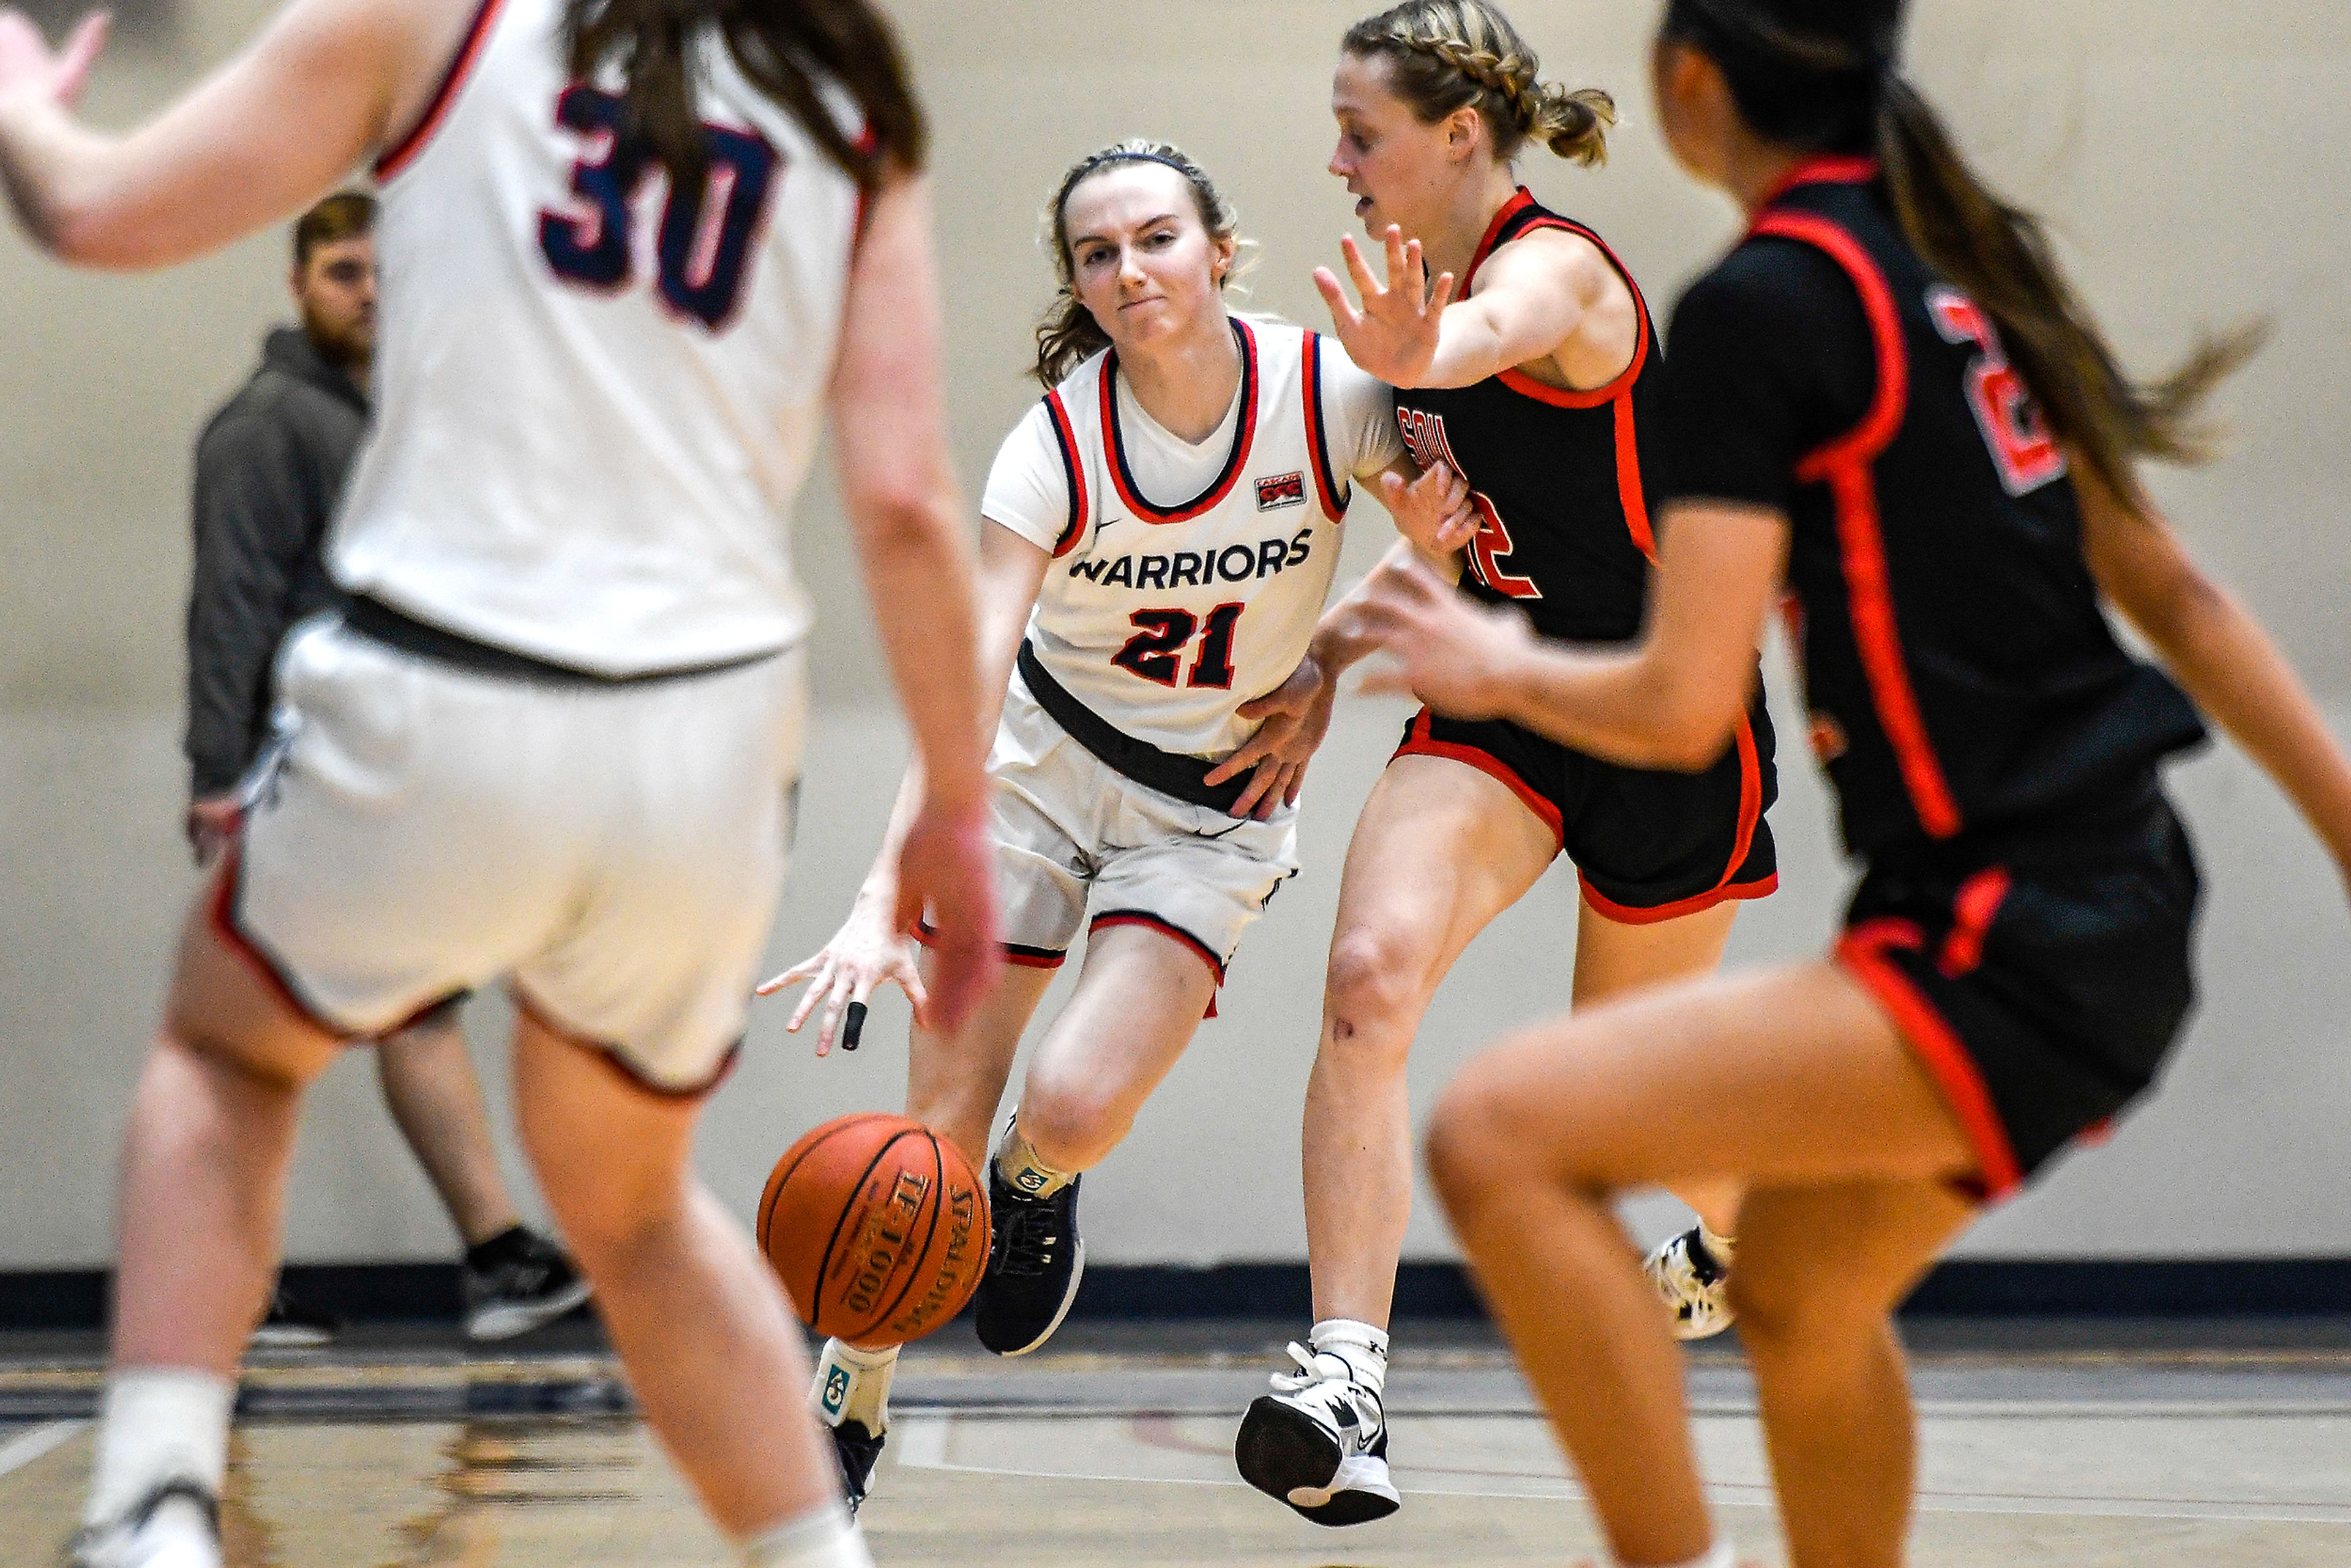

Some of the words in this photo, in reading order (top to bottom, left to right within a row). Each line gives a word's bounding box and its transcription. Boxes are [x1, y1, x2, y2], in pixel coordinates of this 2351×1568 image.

[536, 83, 786, 336] 30
[1069, 528, 1313, 590] WARRIORS
[1111, 601, 1245, 691] 21
[847, 1168, 928, 1314] TF-1000
[891, 1183, 975, 1334] SPALDING
